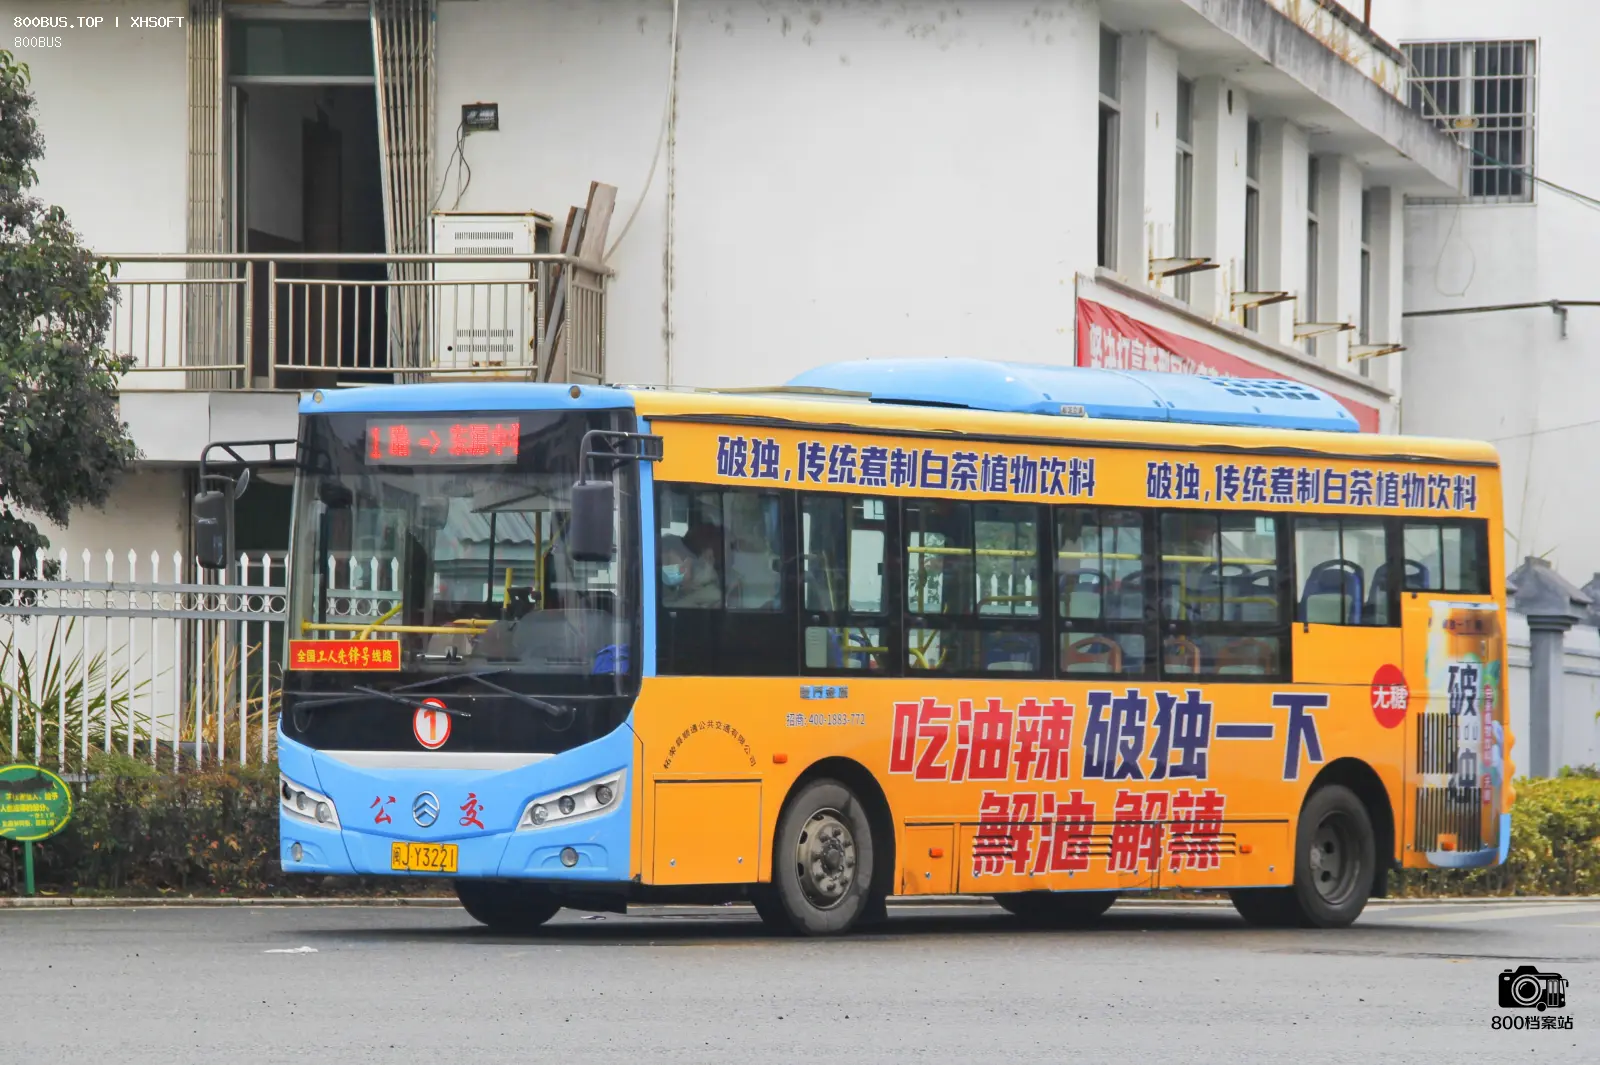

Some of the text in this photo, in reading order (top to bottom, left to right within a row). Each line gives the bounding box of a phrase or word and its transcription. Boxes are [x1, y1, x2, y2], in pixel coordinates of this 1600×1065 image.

[715, 435, 1097, 499] 破独，传统煮制白茶植物饮料
[1146, 460, 1477, 512] 破独，传统煮制白茶植物饮料
[297, 646, 393, 667] 全国工人先锋号线路
